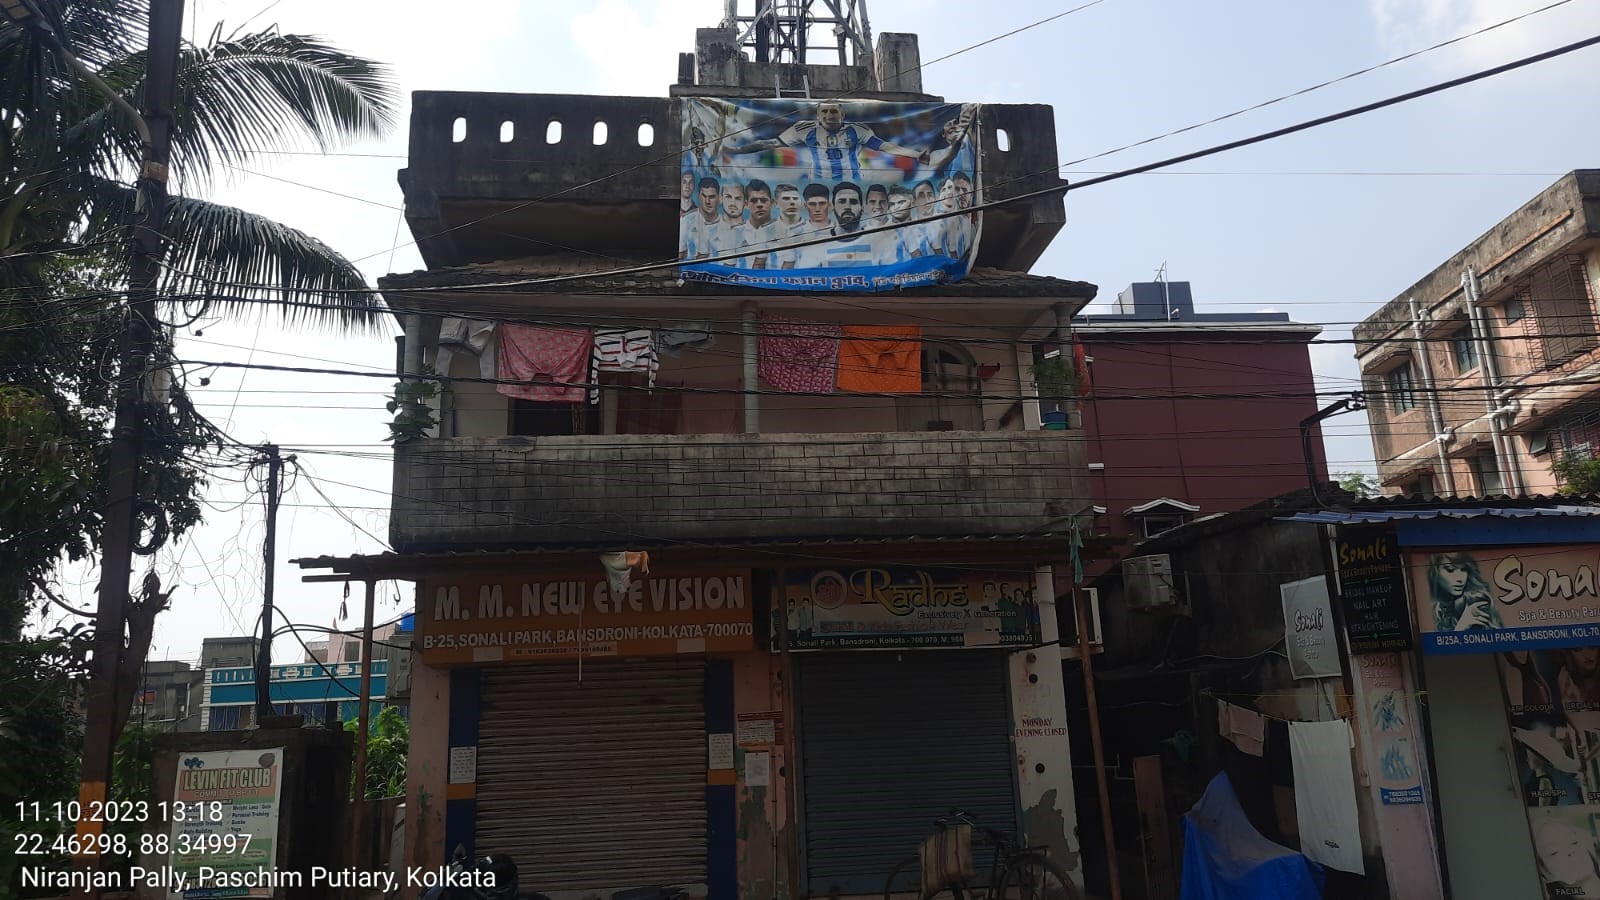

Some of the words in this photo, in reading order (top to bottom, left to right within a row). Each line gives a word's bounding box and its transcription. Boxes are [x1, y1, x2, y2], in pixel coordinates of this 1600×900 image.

[1340, 537, 1388, 566] Sonali
[1493, 554, 1600, 605] Sona
[434, 585, 470, 620] M.
[478, 584, 514, 618] M.
[521, 581, 586, 616] NEW
[593, 579, 643, 614] EYE
[649, 576, 745, 612] VISION
[849, 568, 969, 617] Radhe
[1371, 598, 1387, 608] ART
[973, 609, 1017, 618] Generation
[1519, 610, 1537, 623] Spa
[1539, 608, 1546, 620] &
[1549, 607, 1580, 621] Beauty
[1436, 635, 1462, 646] B/25A,
[1463, 633, 1493, 645] SONALI
[1495, 632, 1519, 644] PARK,
[1520, 629, 1571, 642] BANSDRONI,
[1524, 703, 1555, 712] COLOUR
[1022, 718, 1053, 727] MONDAY
[1015, 728, 1044, 737] EVENING
[1044, 727, 1067, 736] CLOSED
[183, 769, 219, 790] LEVIN
[218, 768, 239, 789] FIT
[239, 767, 271, 788] CLUB
[1531, 790, 1551, 798] HAIR
[1551, 788, 1568, 797] SPA
[1555, 887, 1585, 896] FACIAL
